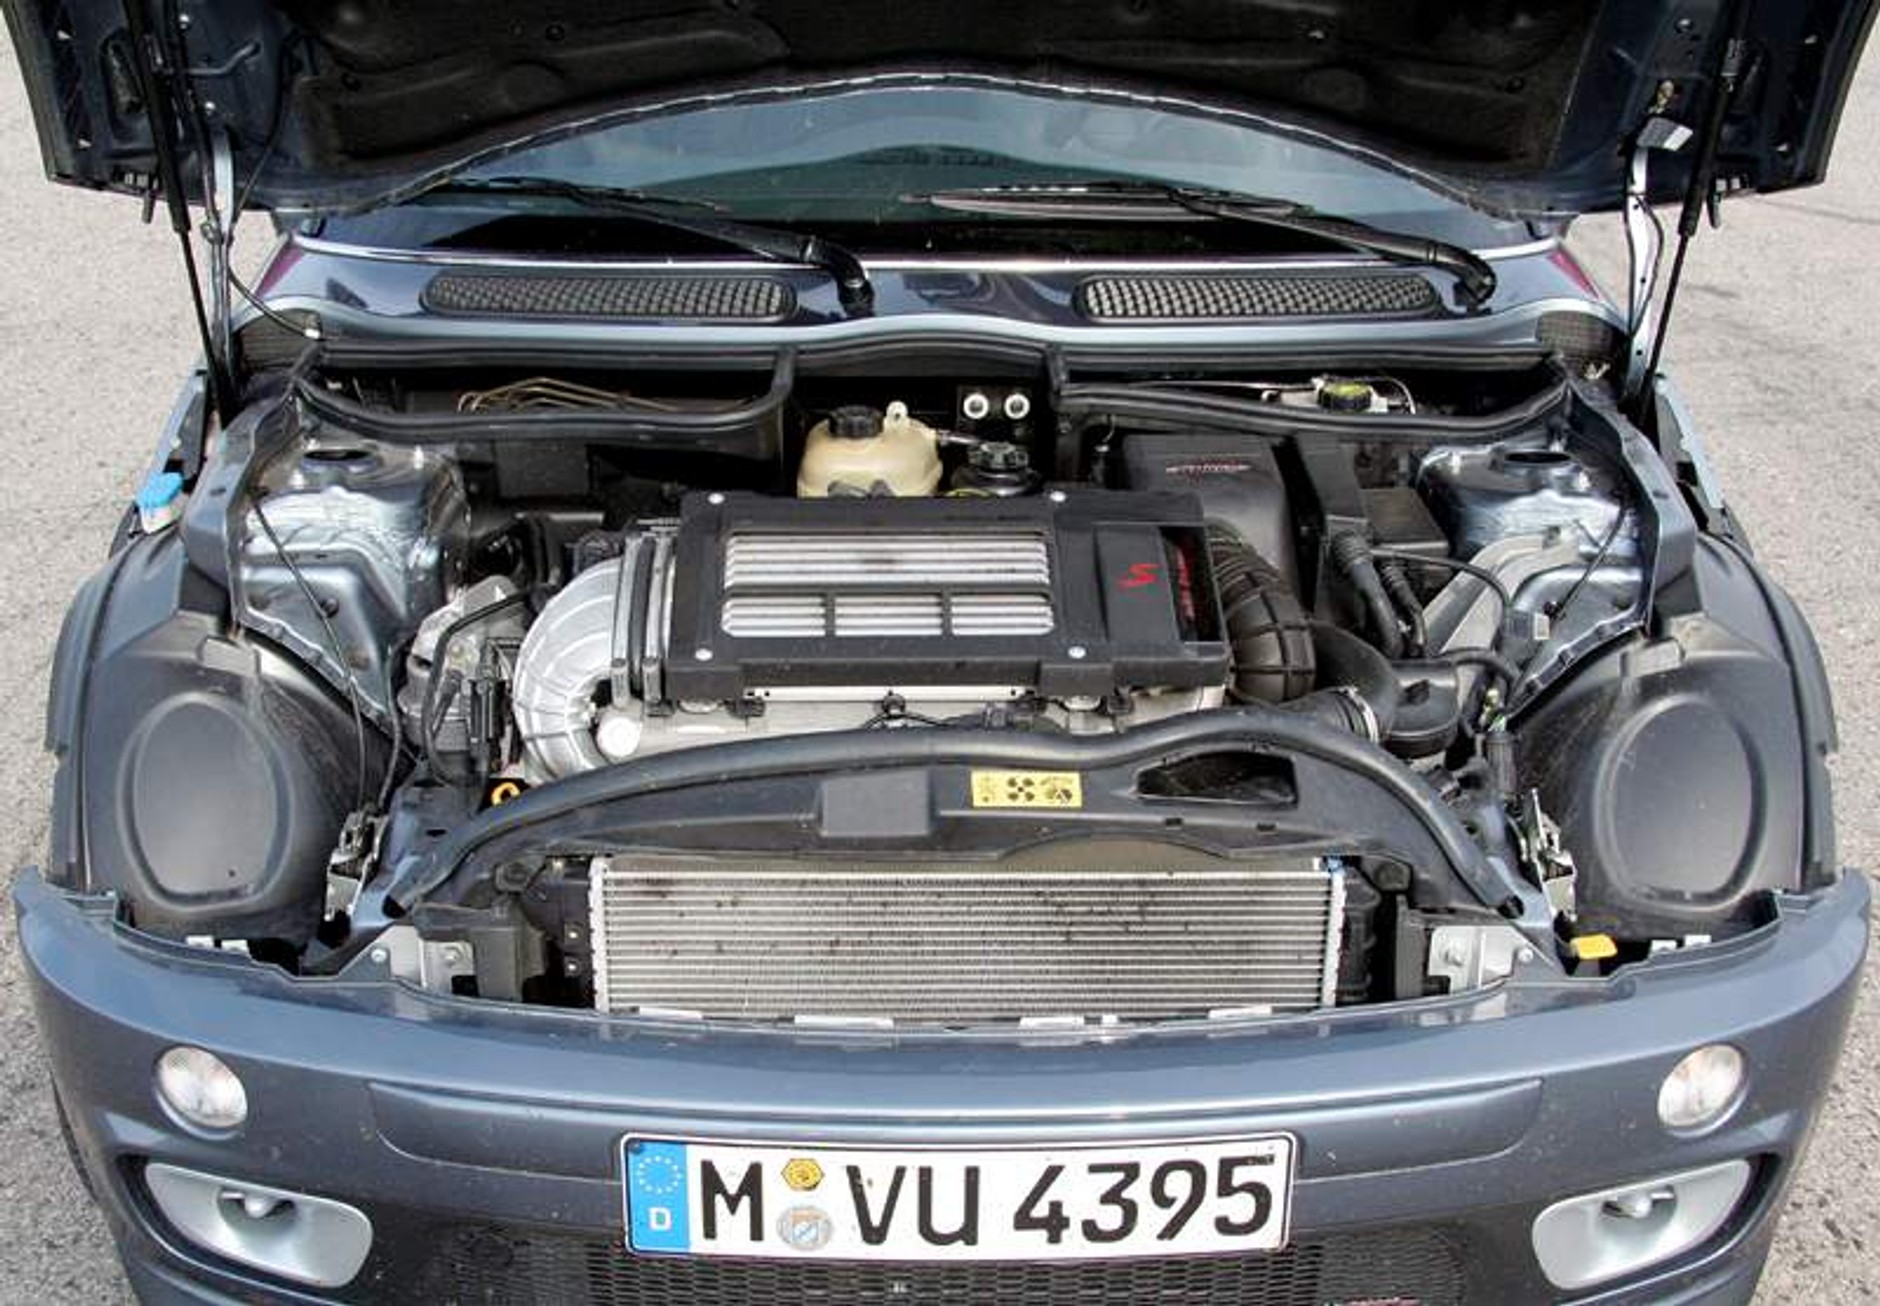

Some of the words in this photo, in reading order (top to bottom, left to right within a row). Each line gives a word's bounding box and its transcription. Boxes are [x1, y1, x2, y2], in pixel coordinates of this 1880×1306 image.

[1116, 562, 1159, 592] S
[700, 1160, 764, 1242] M
[846, 1165, 980, 1246] VU
[1012, 1155, 1275, 1244] 4395
[648, 1206, 672, 1231] D
